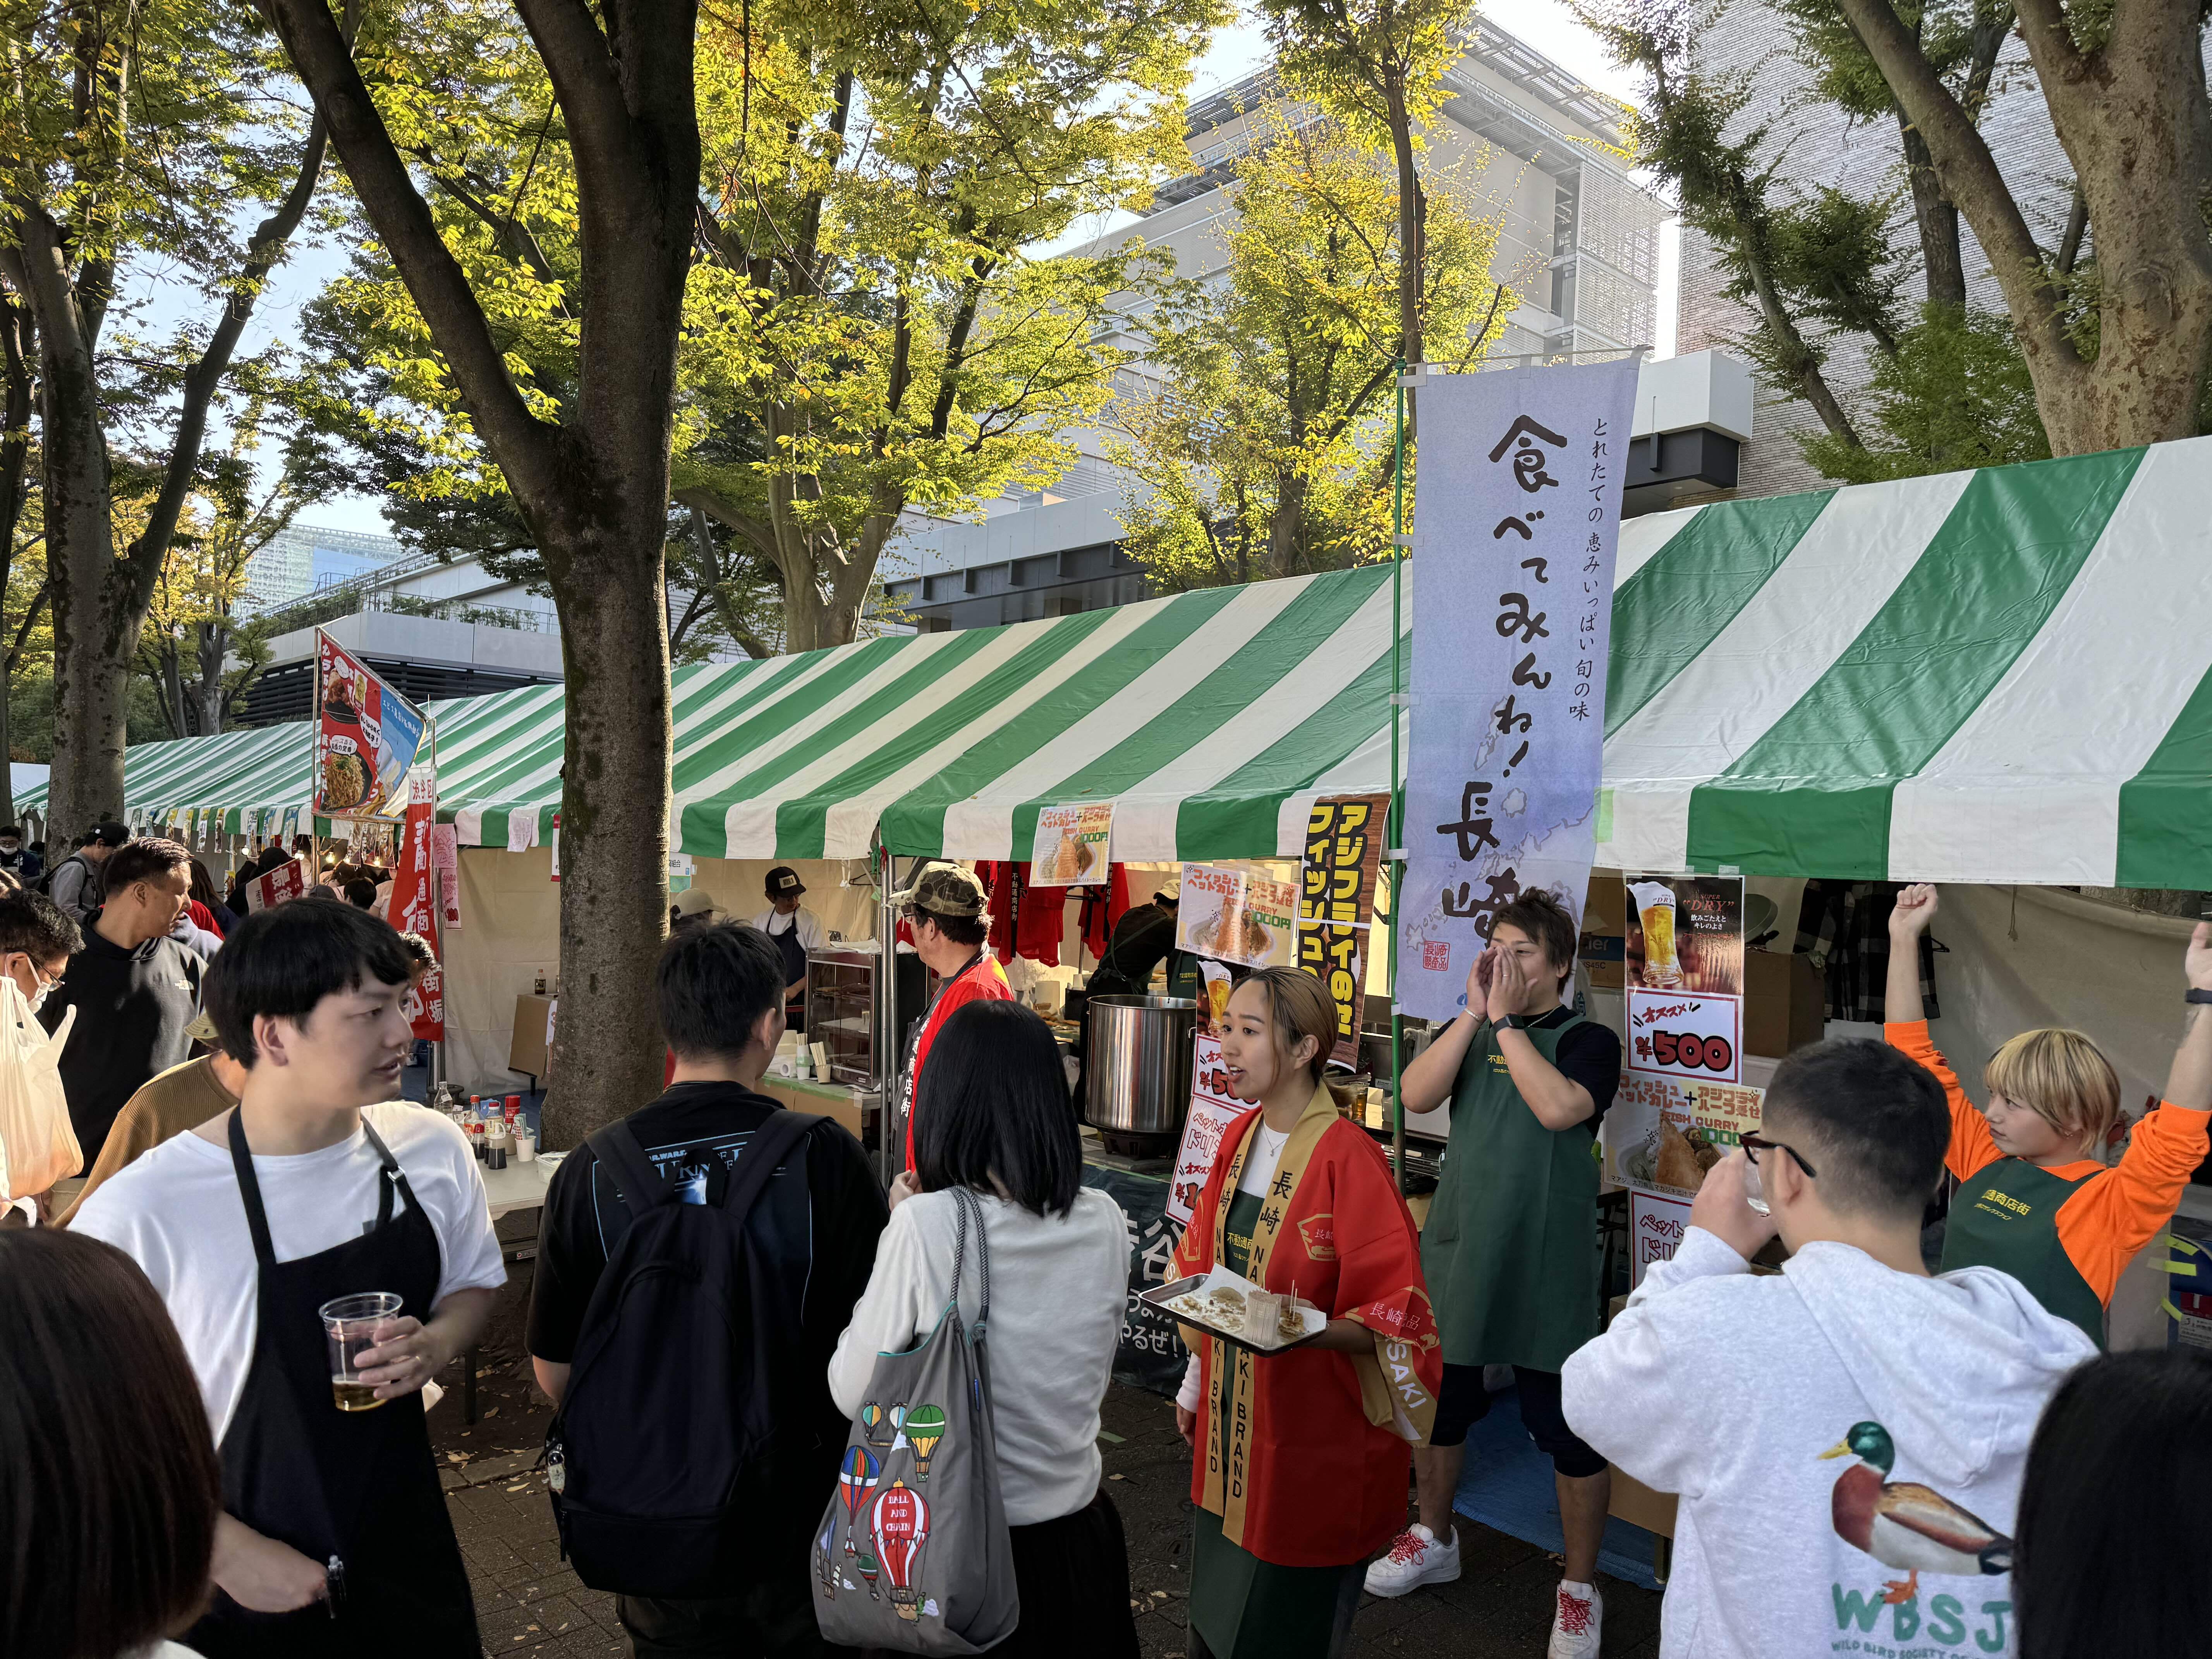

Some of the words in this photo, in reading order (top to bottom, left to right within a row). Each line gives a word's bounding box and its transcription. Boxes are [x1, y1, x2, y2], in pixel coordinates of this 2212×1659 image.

[1589, 418, 1608, 523] とれたての
[1580, 532, 1601, 650] 恵みいっぱい
[1569, 659, 1592, 721] 旬の味
[412, 779, 432, 800] 渋谷区
[1194, 869, 1239, 887] フィッシュ
[1691, 914, 1726, 922] 飲みごたえと
[1585, 939, 1609, 951] ier
[1642, 1002, 1687, 1024] オススメ
[1635, 1030, 1733, 1072] ¥500
[1620, 1075, 1679, 1096] フィッシュ
[1698, 1086, 1760, 1106] アジフライ
[1695, 1116, 1740, 1131] CURRY
[1219, 1154, 1242, 1215] 長崎
[1259, 1170, 1294, 1235] 長崎
[1232, 1402, 1246, 1499] BRAND
[888, 1494, 910, 1504] BALL
[890, 1508, 908, 1518] AND
[886, 1522, 910, 1532] CHAIN
[1831, 1582, 2013, 1654] WBSJ
[1831, 1640, 1860, 1651] WILD
[1863, 1641, 1896, 1659] BIRD
[1899, 1647, 1946, 1659] SOCIETY
